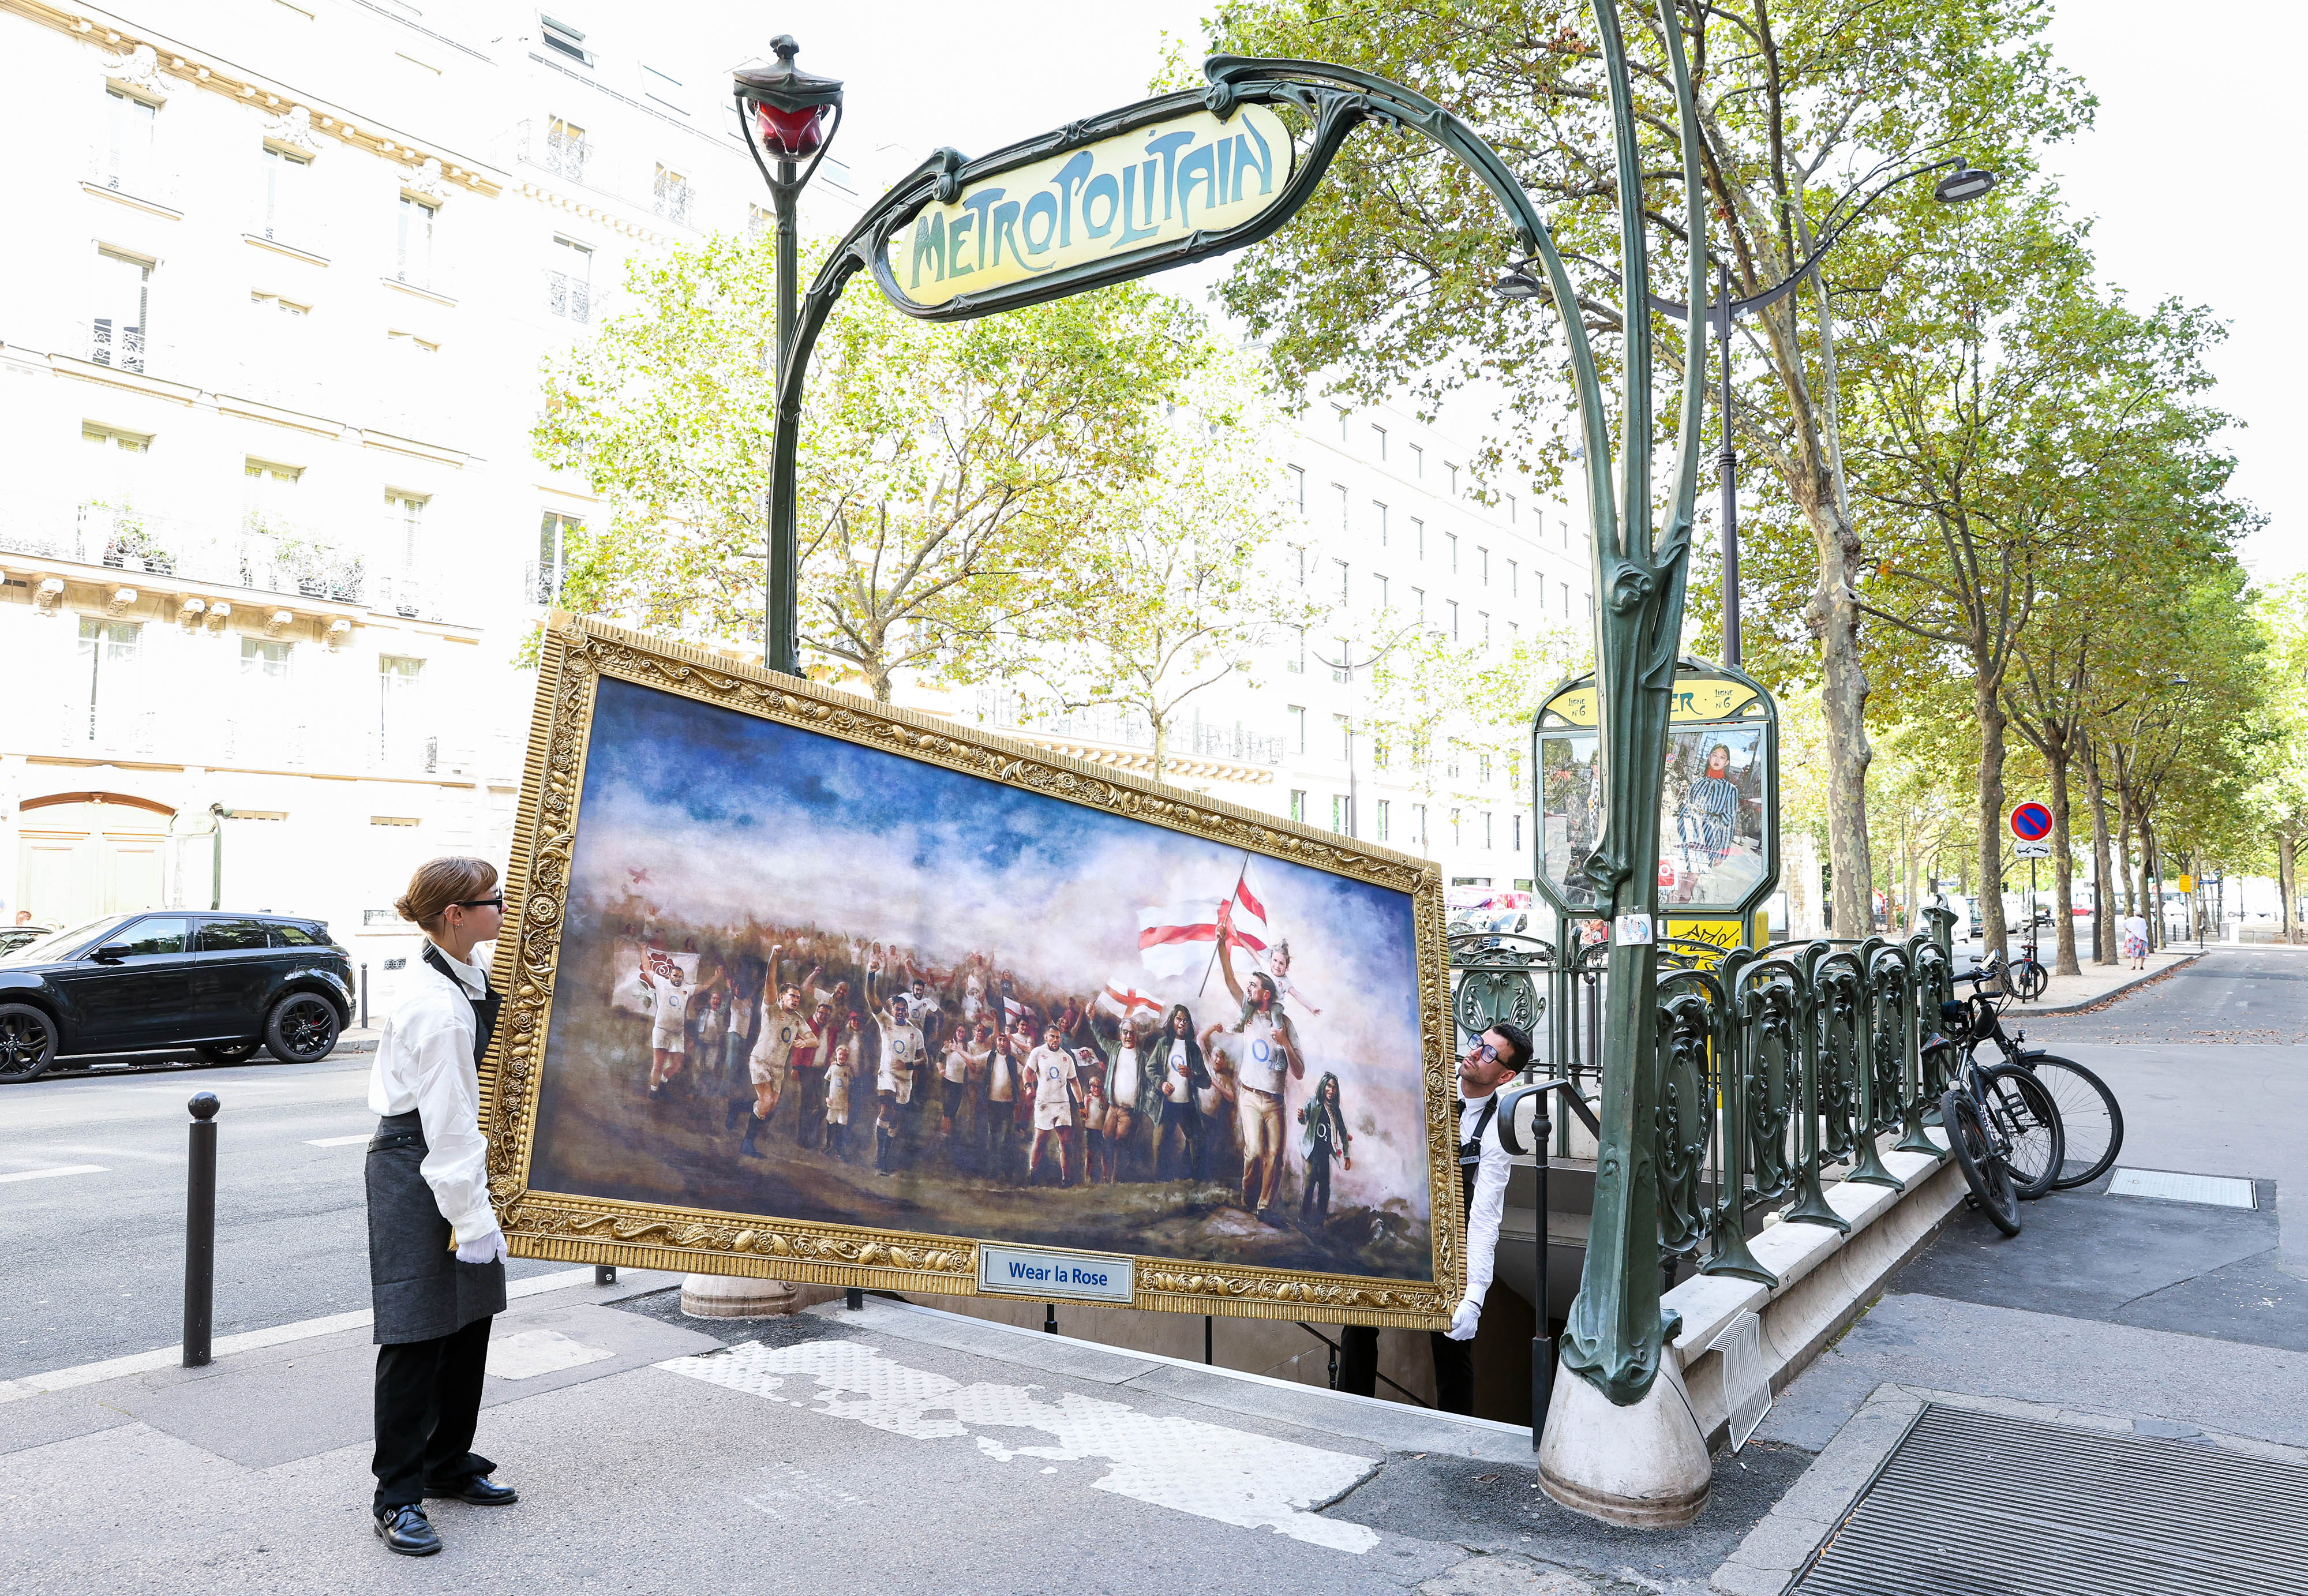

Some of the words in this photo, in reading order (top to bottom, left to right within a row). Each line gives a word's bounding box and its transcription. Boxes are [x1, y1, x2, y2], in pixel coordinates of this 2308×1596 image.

[910, 113, 1272, 289] METROPOLITAIN
[1579, 705, 1586, 716] 6
[1723, 696, 1730, 708] 6
[1009, 1261, 1051, 1281] Wear
[1055, 1265, 1067, 1282] la
[1073, 1268, 1108, 1286] Rose
